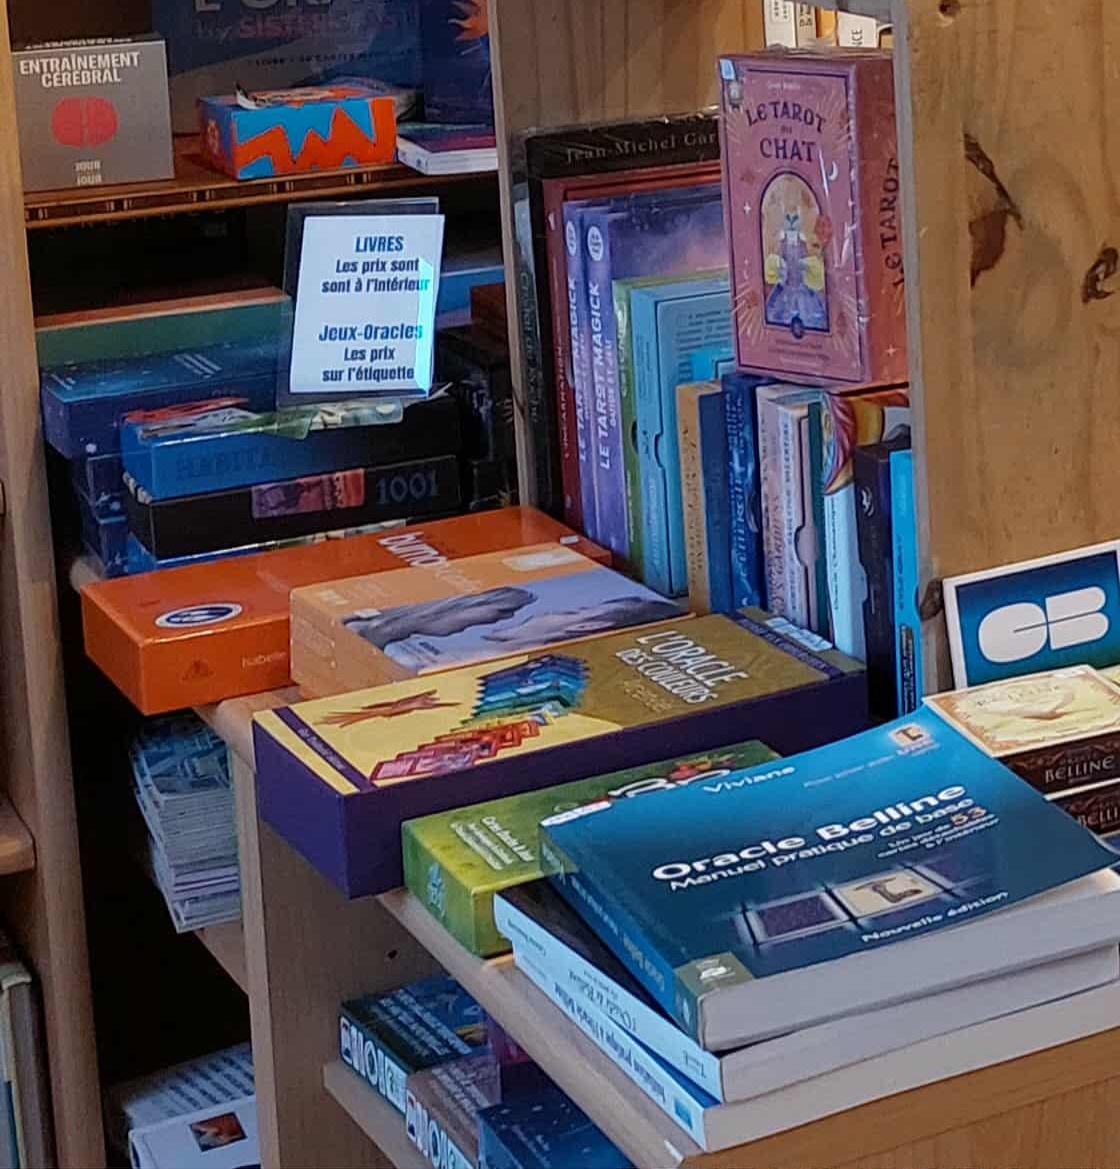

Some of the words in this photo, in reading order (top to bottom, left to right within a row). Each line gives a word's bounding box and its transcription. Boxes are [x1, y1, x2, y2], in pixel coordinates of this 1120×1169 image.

[760, 137, 816, 162] CHAT
[354, 235, 405, 253] LIVRES
[335, 257, 359, 274] Les
[362, 256, 389, 275] prix
[390, 256, 419, 273] sont
[321, 278, 354, 293] sont
[355, 276, 363, 292] à
[318, 322, 424, 342] Jeux-Oracles
[588, 280, 604, 366] MAGICK
[343, 346, 366, 362] Les
[369, 346, 395, 363] prix
[321, 367, 345, 382] sur
[347, 365, 415, 383] l'étiquette
[595, 371, 609, 438] TAROT
[598, 445, 611, 470] LE
[636, 629, 749, 687] L'ORACLE
[703, 765, 795, 793] Viviane
[1044, 756, 1115, 783] BELLINE
[950, 806, 987, 826] 53
[653, 835, 806, 881] Oracle
[816, 785, 967, 841] Belline
[669, 858, 768, 891] Manuel
[773, 833, 876, 867] pratique
[879, 820, 913, 837] de
[916, 797, 975, 823] base
[861, 911, 944, 943] Nouvelle
[946, 890, 1009, 917] édition
